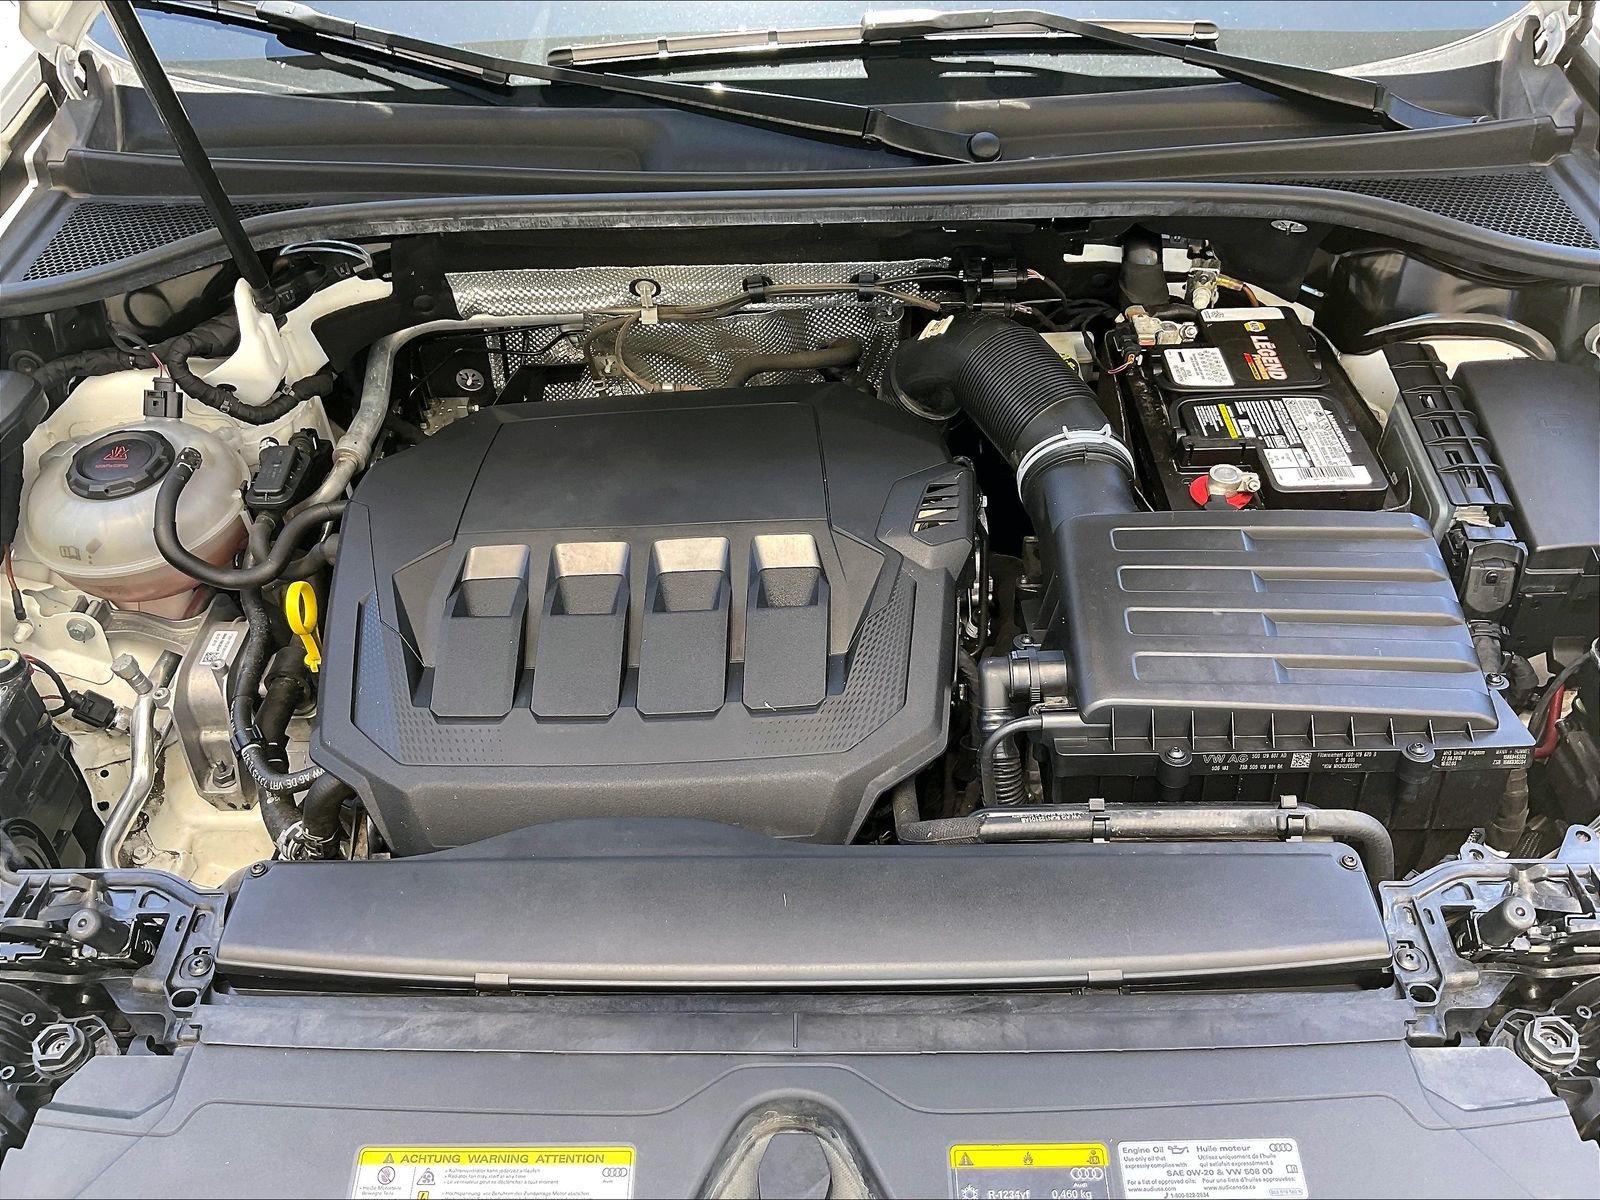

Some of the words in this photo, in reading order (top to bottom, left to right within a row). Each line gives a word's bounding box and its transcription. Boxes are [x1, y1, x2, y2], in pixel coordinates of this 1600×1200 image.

[1202, 754, 1226, 764] VW
[1227, 753, 1249, 764] AG
[1122, 1147, 1151, 1155] Engine
[400, 1154, 461, 1164] ACHTUNG
[468, 1154, 529, 1164] WARNING
[535, 1154, 605, 1164] ATTENTION
[1166, 1169, 1185, 1177] SAE
[1186, 1169, 1215, 1177] 0W-20
[1225, 1168, 1242, 1176] VW
[1244, 1168, 1260, 1176] 508
[1158, 1179, 1184, 1187] approved
[1080, 1189, 1093, 1199] kg
